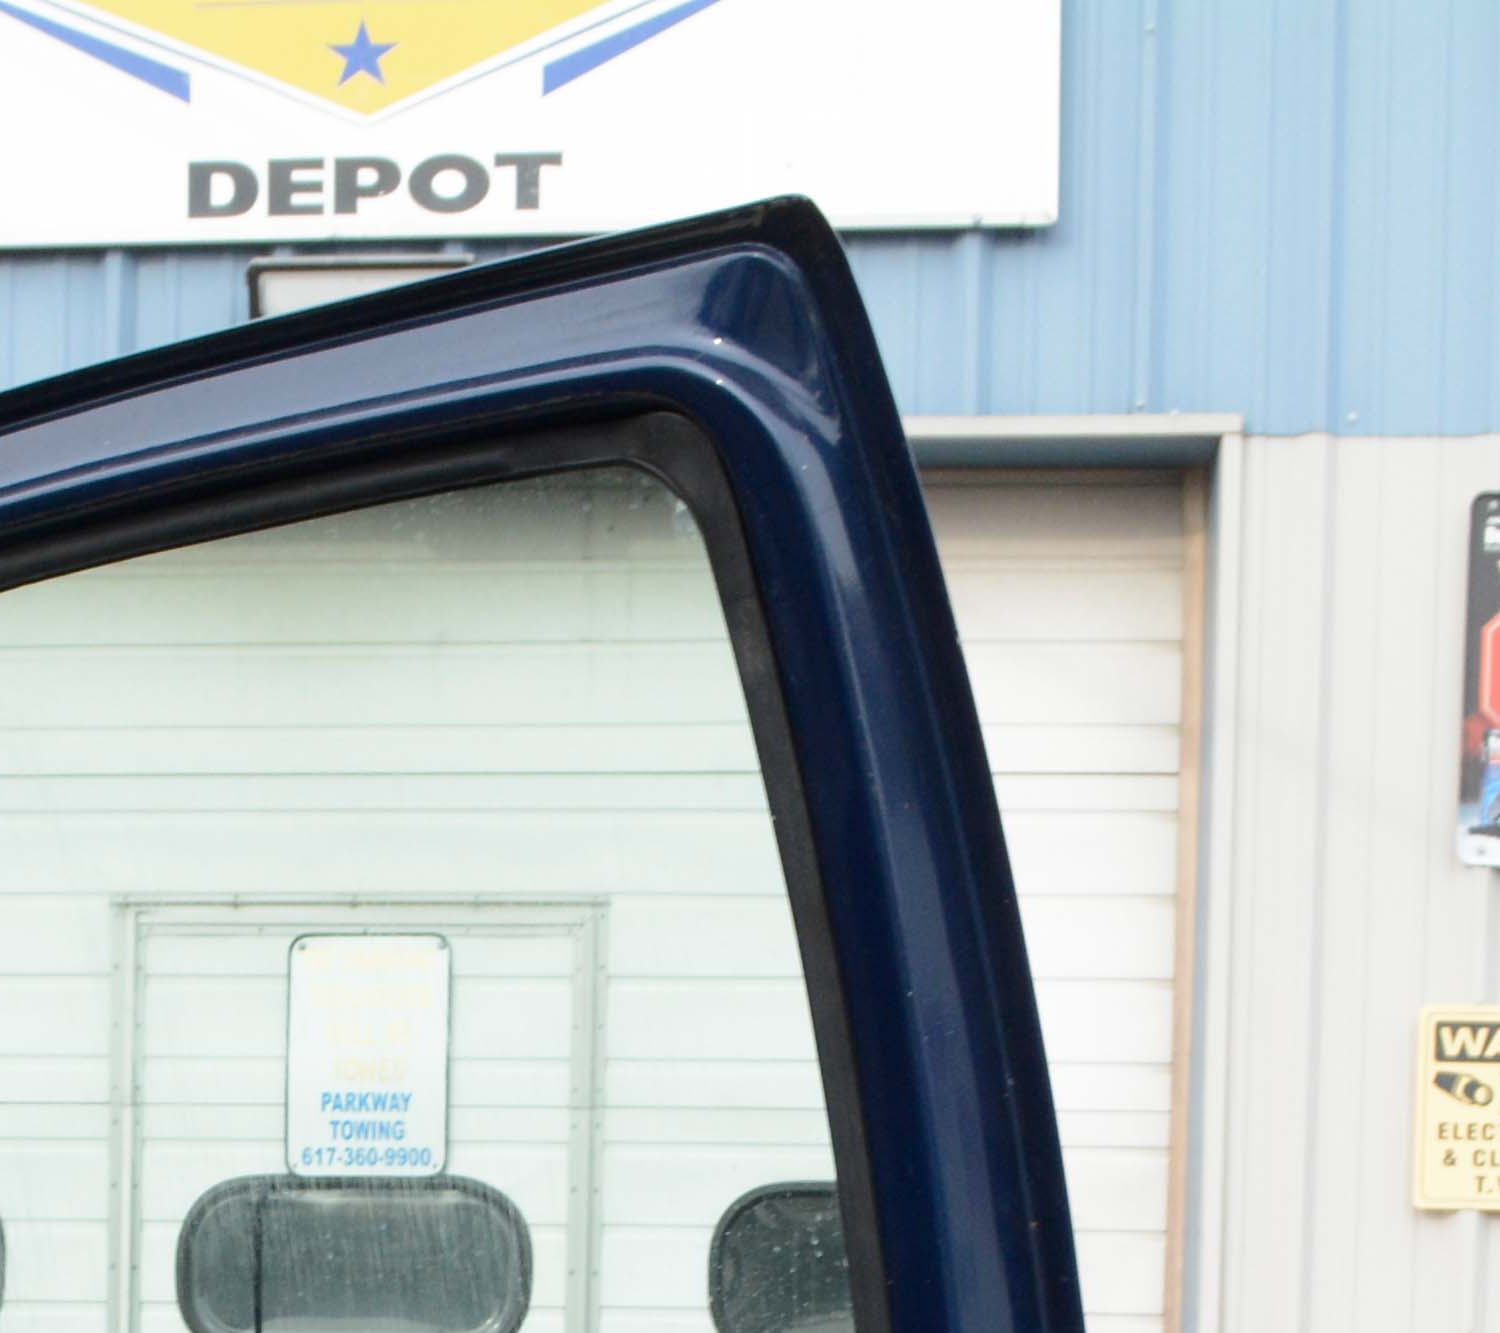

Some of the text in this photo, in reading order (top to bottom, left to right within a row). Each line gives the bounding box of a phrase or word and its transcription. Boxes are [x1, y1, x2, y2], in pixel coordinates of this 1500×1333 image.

[187, 151, 563, 219] DEPOT
[320, 1091, 413, 1113] PARKWAY
[329, 1119, 406, 1141] TOWING
[1442, 1149, 1457, 1167] &
